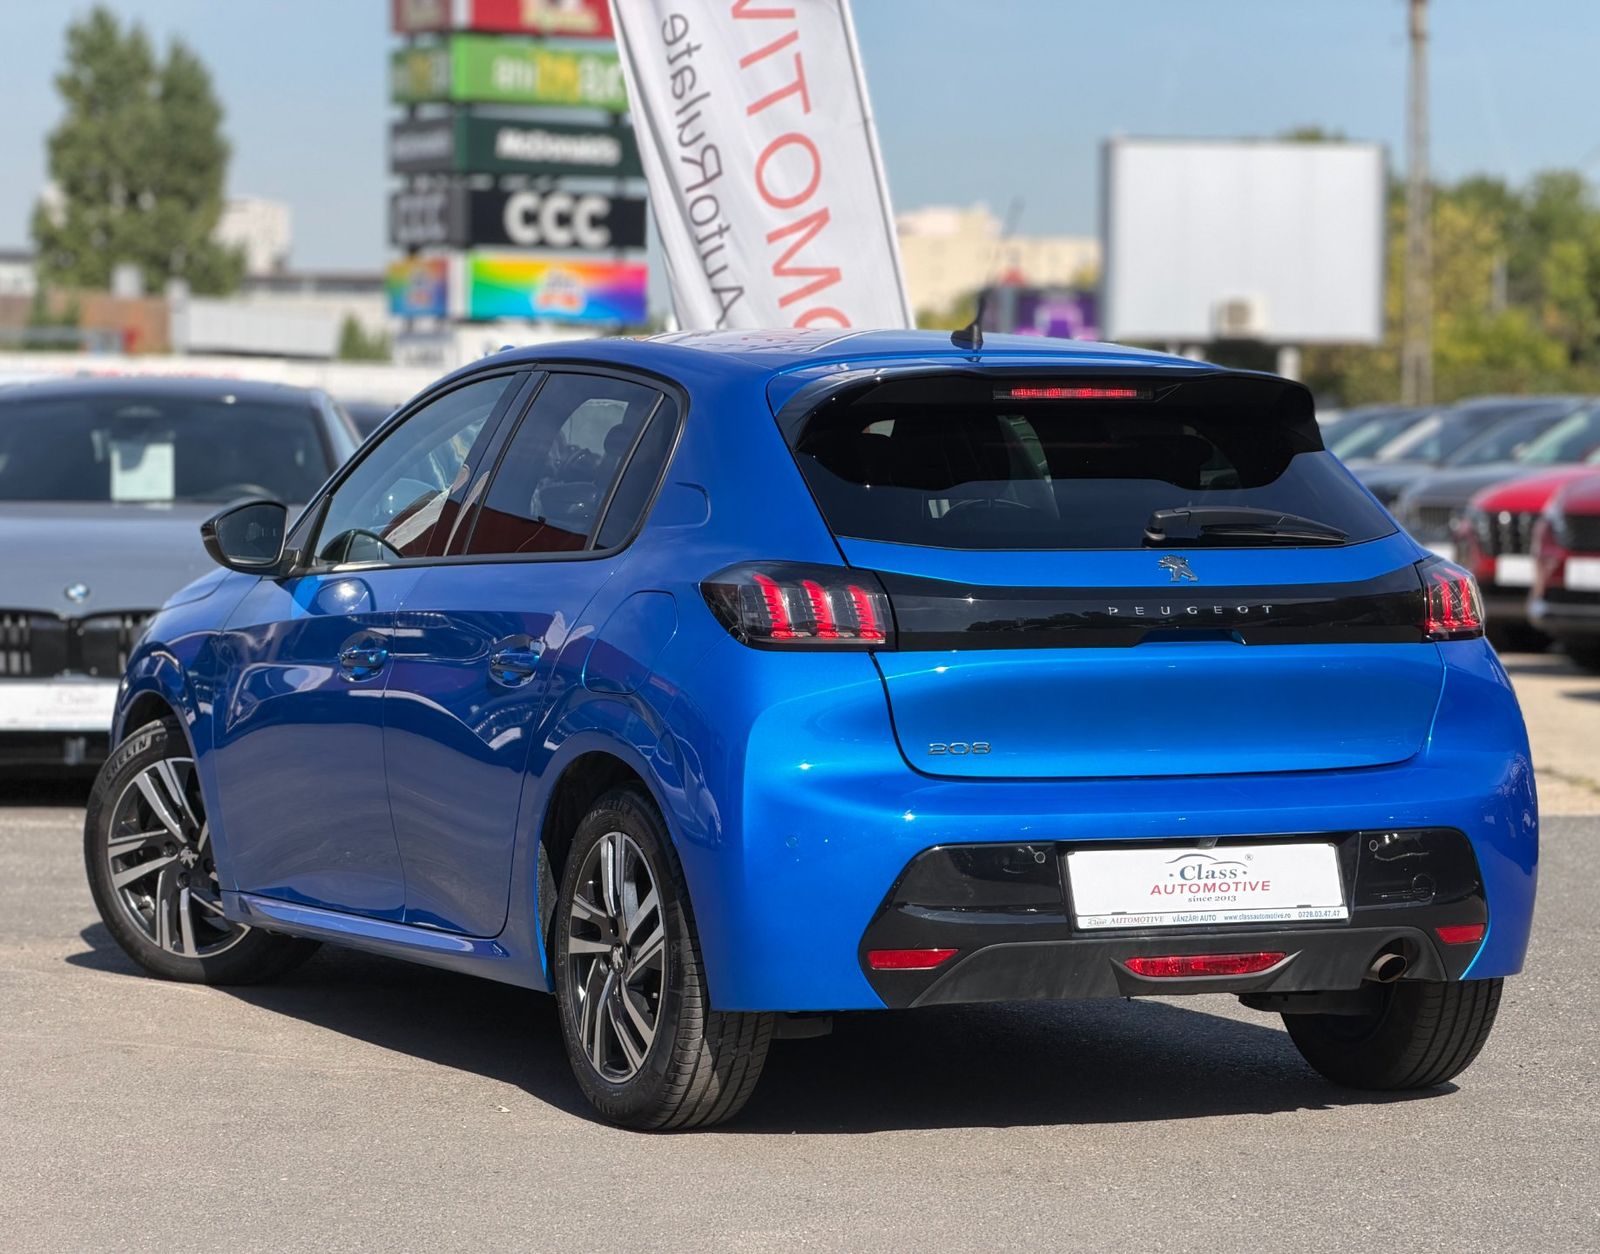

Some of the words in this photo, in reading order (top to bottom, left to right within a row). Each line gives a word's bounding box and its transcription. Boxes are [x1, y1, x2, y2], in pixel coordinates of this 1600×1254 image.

[504, 191, 611, 246] CCC
[1107, 605, 1273, 616] PEUGEOT
[928, 741, 991, 755] 208
[1179, 863, 1238, 881] Class
[1150, 880, 1271, 896] AUTOMOTIVE
[1187, 895, 1212, 903] since
[1200, 914, 1217, 922] AUTO
[1224, 912, 1291, 921] www.classautomotive.ro
